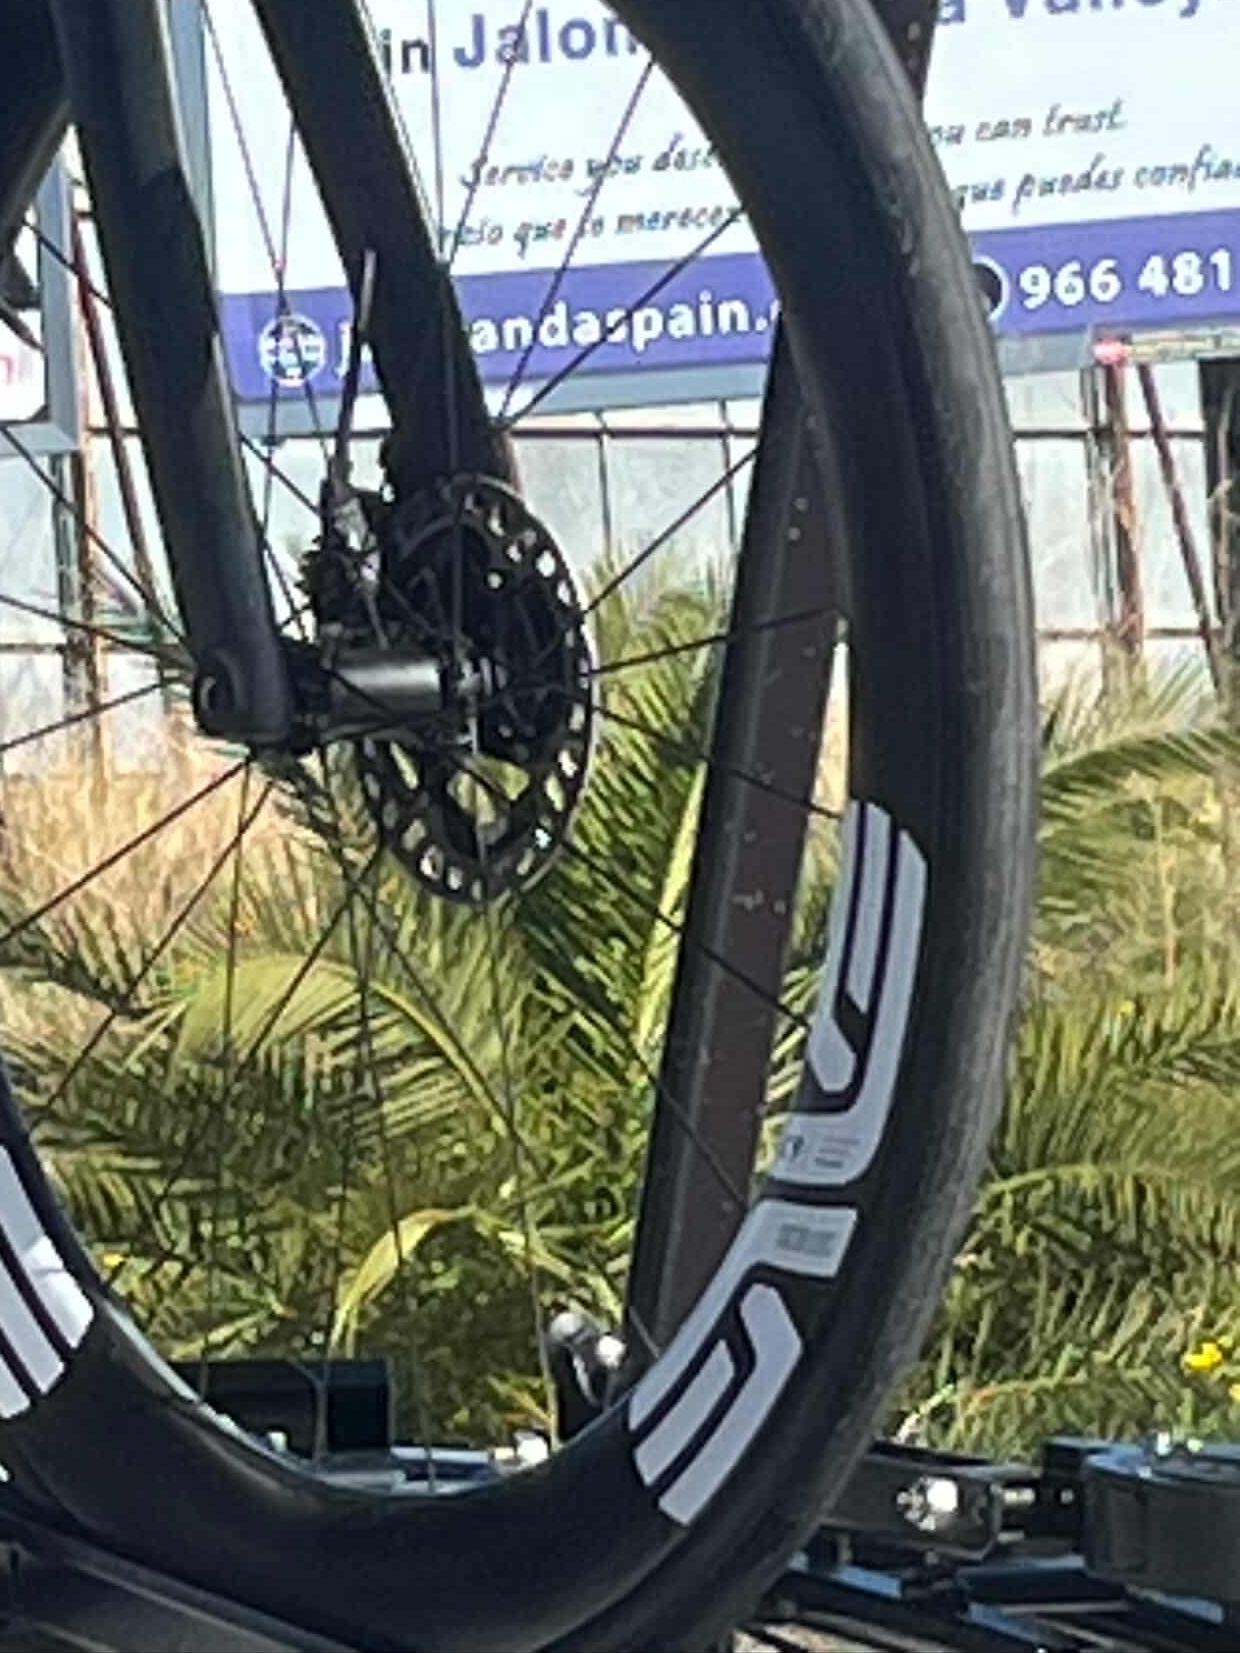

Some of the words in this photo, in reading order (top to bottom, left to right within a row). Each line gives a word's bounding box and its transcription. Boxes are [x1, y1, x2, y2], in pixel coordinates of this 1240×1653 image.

[377, 29, 431, 75] in
[1018, 257, 1123, 311] 966
[1137, 247, 1233, 297] 481
